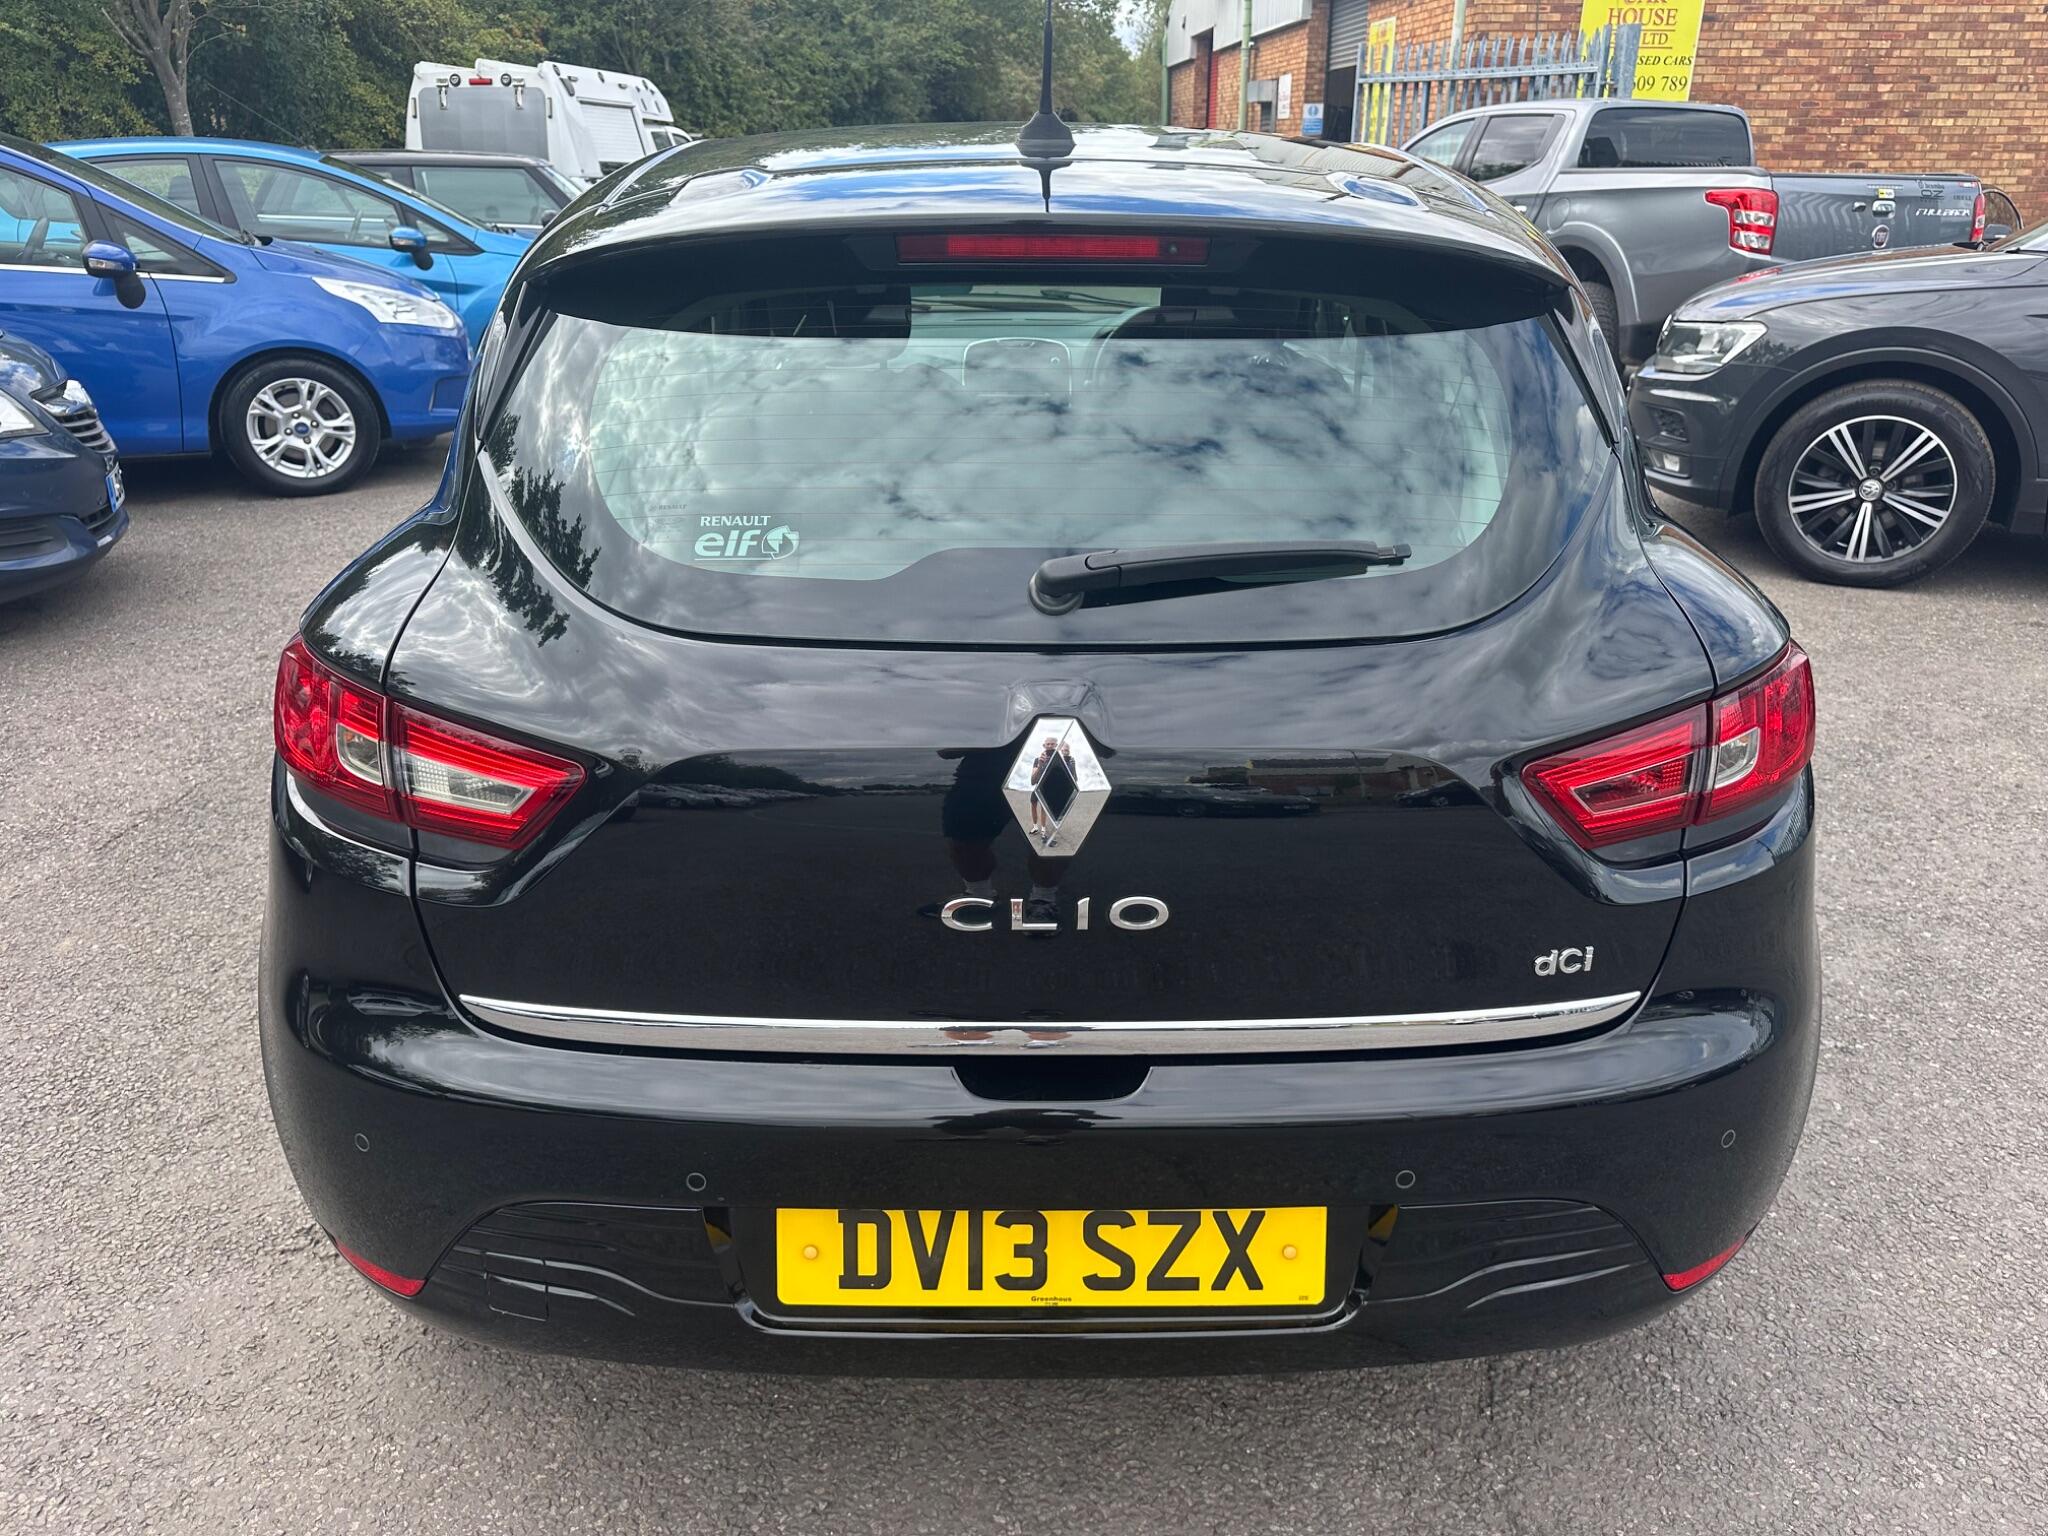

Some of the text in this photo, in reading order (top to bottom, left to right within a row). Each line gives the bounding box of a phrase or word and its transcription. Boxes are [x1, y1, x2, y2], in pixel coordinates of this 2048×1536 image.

[1608, 8, 1678, 26] HOUSE
[1642, 32, 1668, 45] LTD
[1636, 56, 1693, 66] SED CARS
[1661, 76, 1688, 92] 789
[700, 515, 771, 526] RENAULT
[694, 529, 761, 557] elf
[941, 896, 1169, 931] CLIO
[838, 1209, 1266, 1291] DV13 SZX
